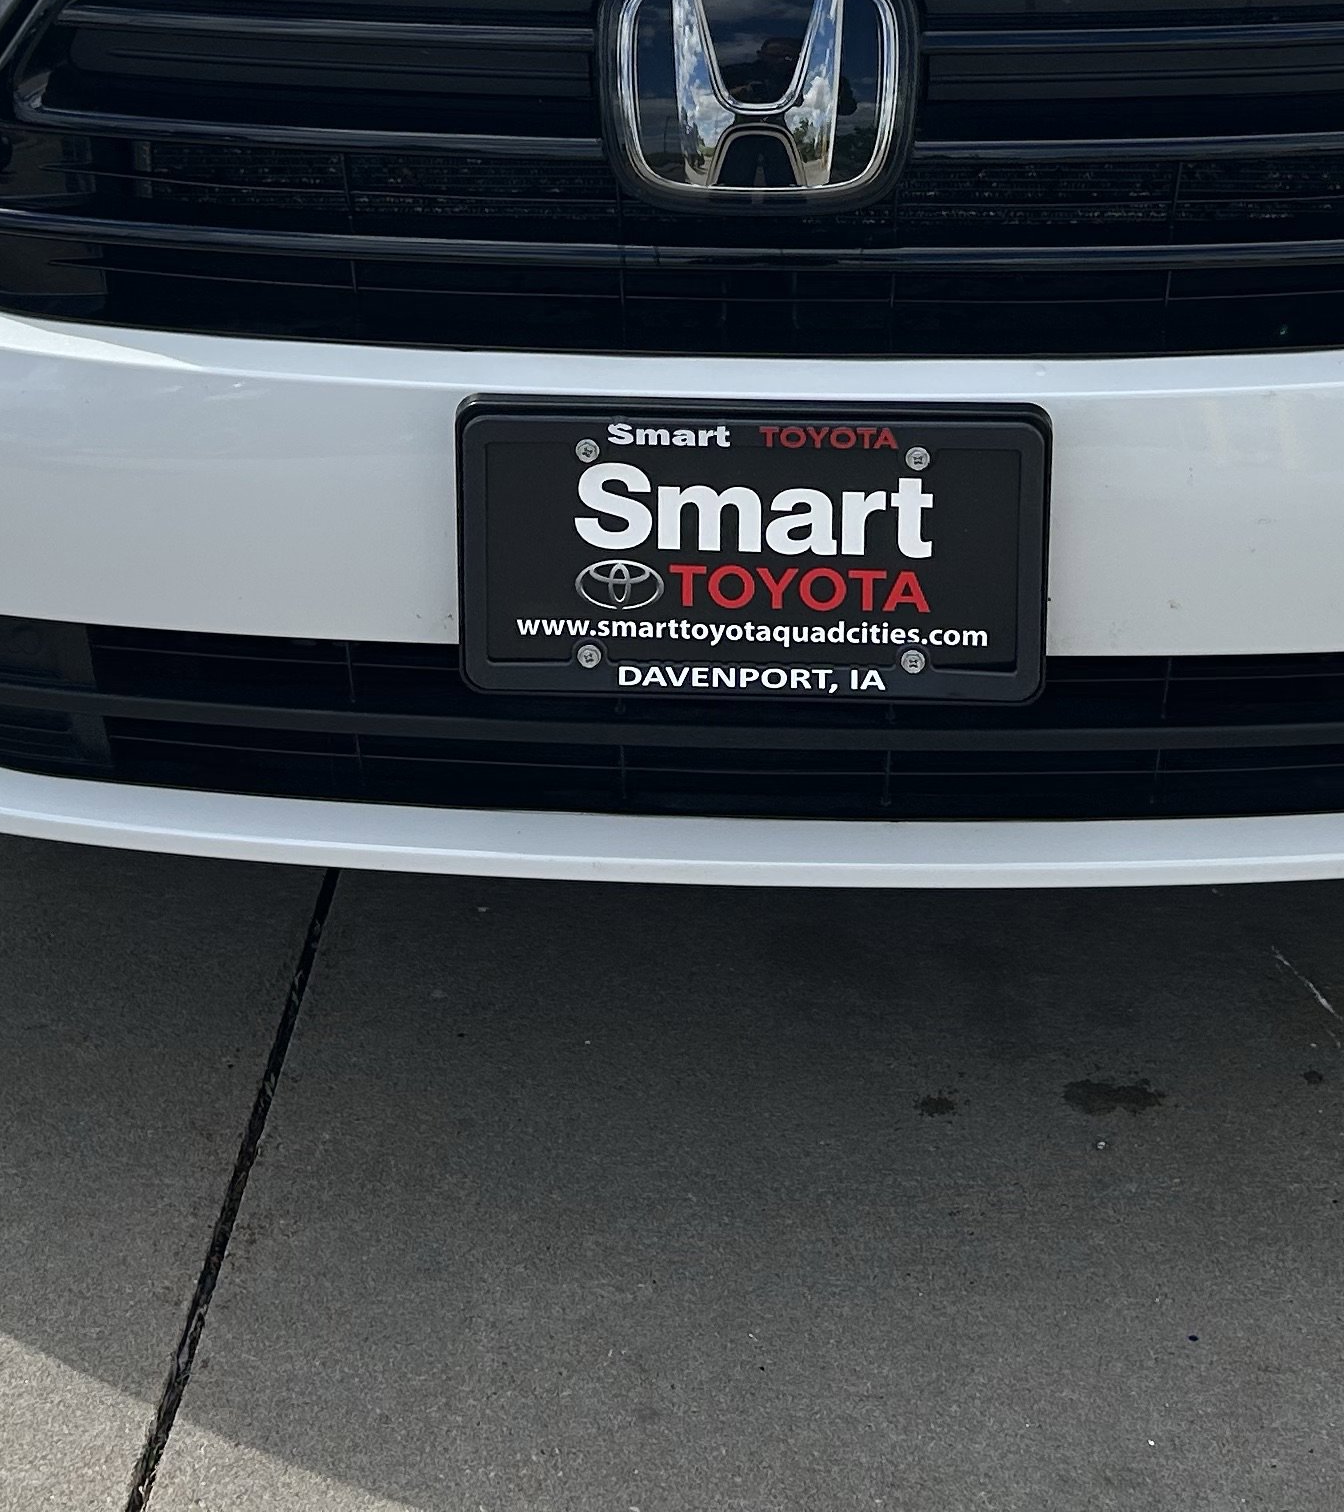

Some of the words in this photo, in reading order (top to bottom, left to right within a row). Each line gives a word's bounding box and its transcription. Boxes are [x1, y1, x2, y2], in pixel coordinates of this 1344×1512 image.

[607, 422, 731, 448] Smart
[759, 426, 898, 450] TOYOTA
[574, 462, 934, 558] Smart
[669, 563, 931, 613] TOYOTA
[516, 617, 989, 649] www.smarttoyotaquadcities.com
[617, 665, 838, 694] DAVENPORT,
[850, 669, 886, 691] IA
